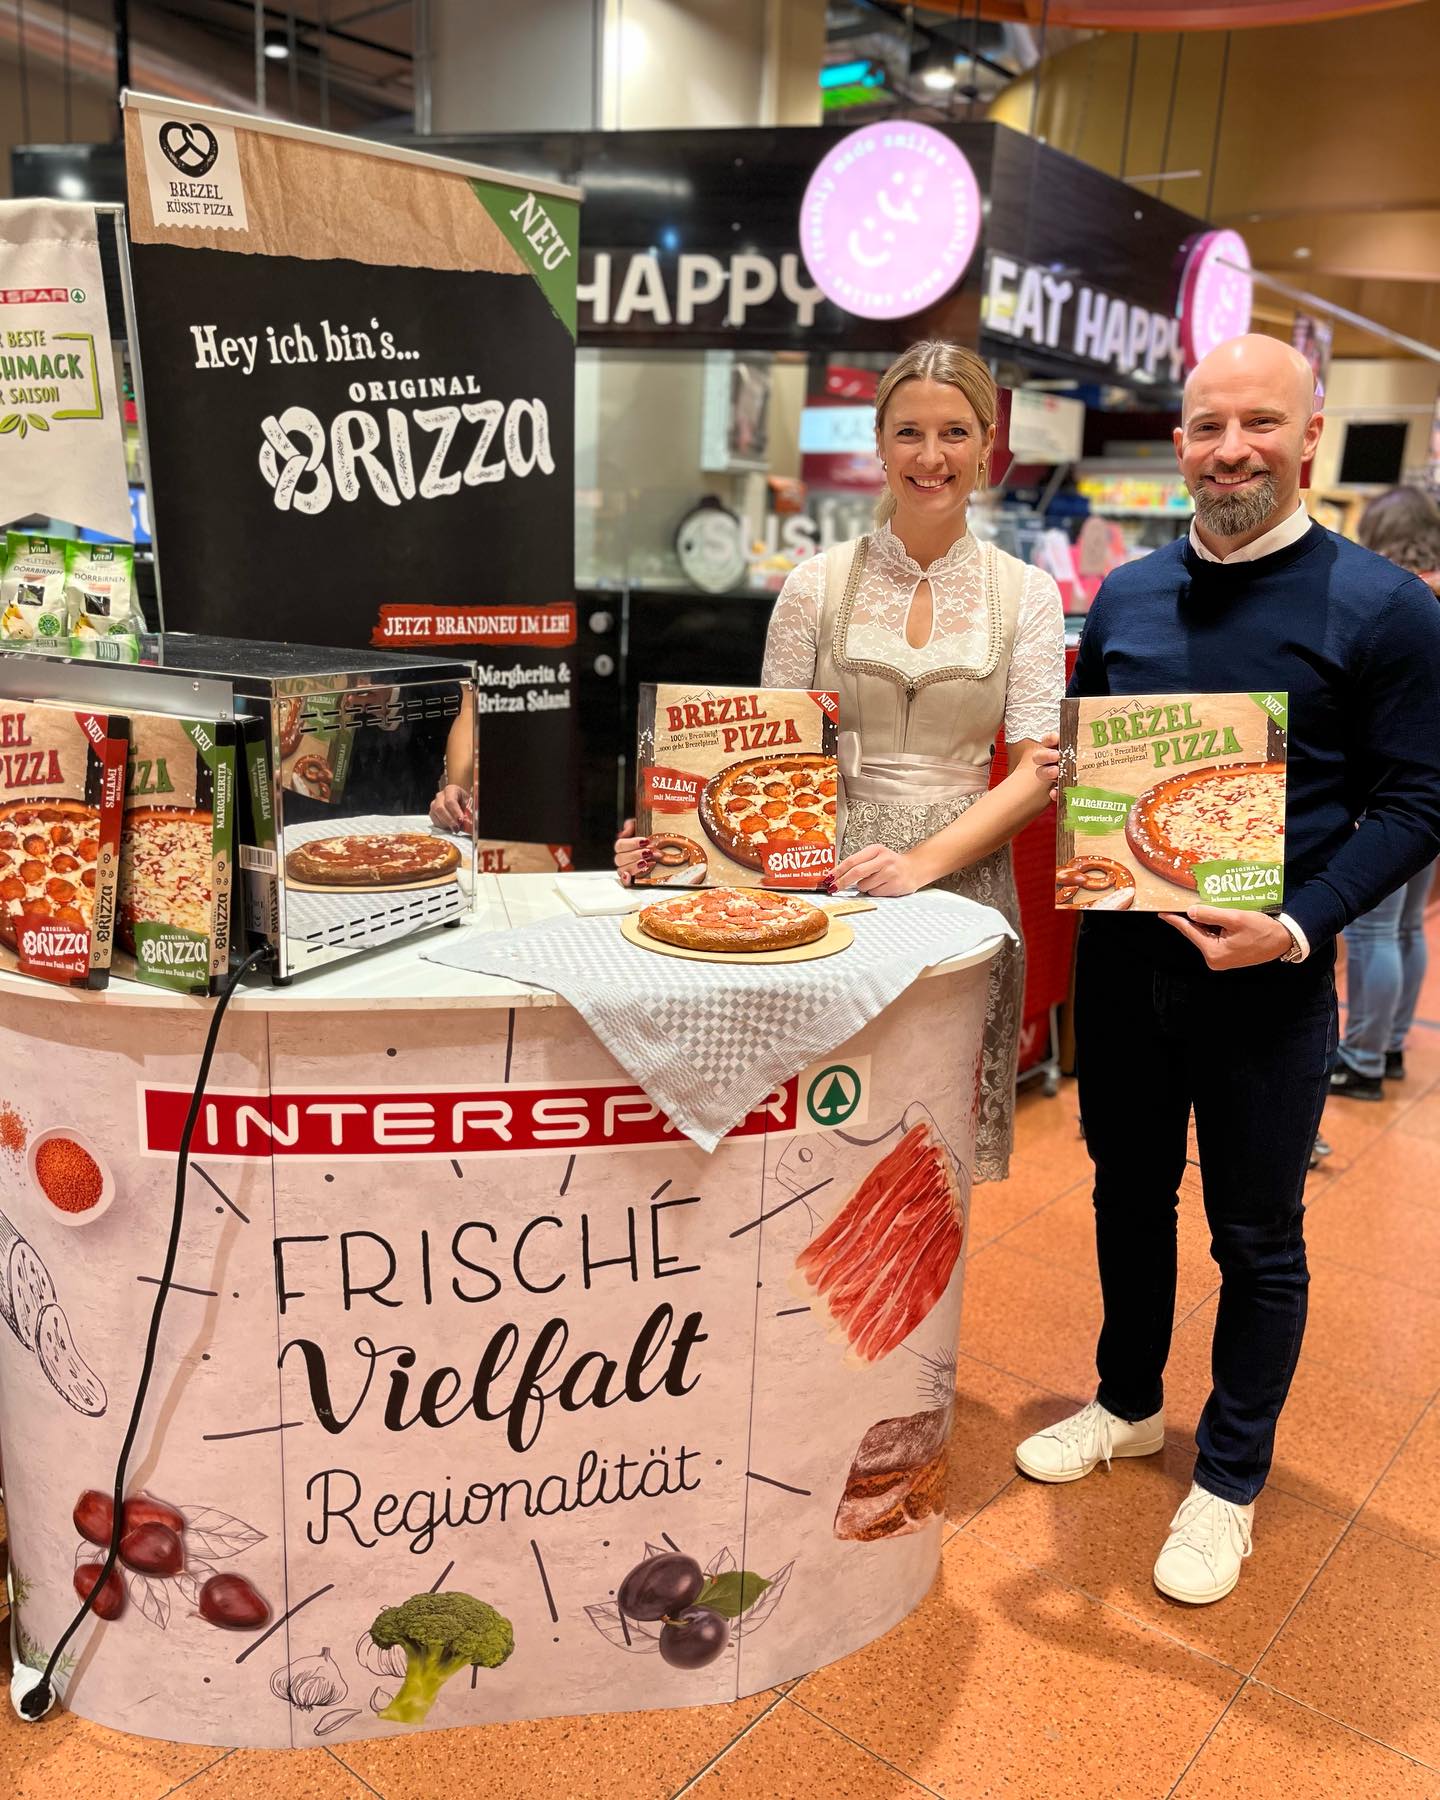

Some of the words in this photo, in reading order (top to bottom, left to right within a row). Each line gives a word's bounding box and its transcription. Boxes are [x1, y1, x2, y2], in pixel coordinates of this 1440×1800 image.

[169, 181, 224, 200] BREZEL
[166, 199, 201, 214] KÜSST
[204, 202, 234, 217] PIZZA
[510, 193, 572, 272] NEU
[7, 330, 47, 348] BESTE
[190, 325, 260, 374] Hey
[269, 323, 319, 365] ich
[1074, 286, 1185, 383] HAPPY
[0, 353, 84, 381] HMACK
[10, 386, 60, 405] SAISON
[349, 375, 482, 403] ORIGINAL
[384, 616, 432, 636] JETZT
[435, 615, 518, 635] BRANDNEU
[520, 615, 541, 634] IM
[542, 614, 570, 634] LEH!
[478, 663, 556, 689] Margherita
[557, 662, 571, 683] &
[478, 690, 525, 714] Brizza
[526, 689, 571, 712] Salami
[666, 695, 767, 732] BREZEL
[817, 692, 838, 712] NEU
[1262, 695, 1286, 716] NEU
[83, 715, 105, 743] NEU
[190, 723, 213, 752] NEU
[722, 719, 802, 753] PIZZA
[1089, 702, 1202, 749] BREZEL
[1152, 726, 1243, 768] PIZZA
[0, 749, 65, 789] IZZA
[104, 768, 117, 808] SALAMI
[215, 762, 227, 829] MARGHERITA
[652, 775, 697, 794] SALAMI
[653, 793, 664, 801] mit
[1071, 797, 1127, 812] MARGHERITA
[205, 1085, 790, 1148] INTERSPR
[274, 1197, 702, 1315] FRISCHE
[277, 1302, 708, 1453] Vielfalt
[305, 1445, 702, 1554] Regionalität
